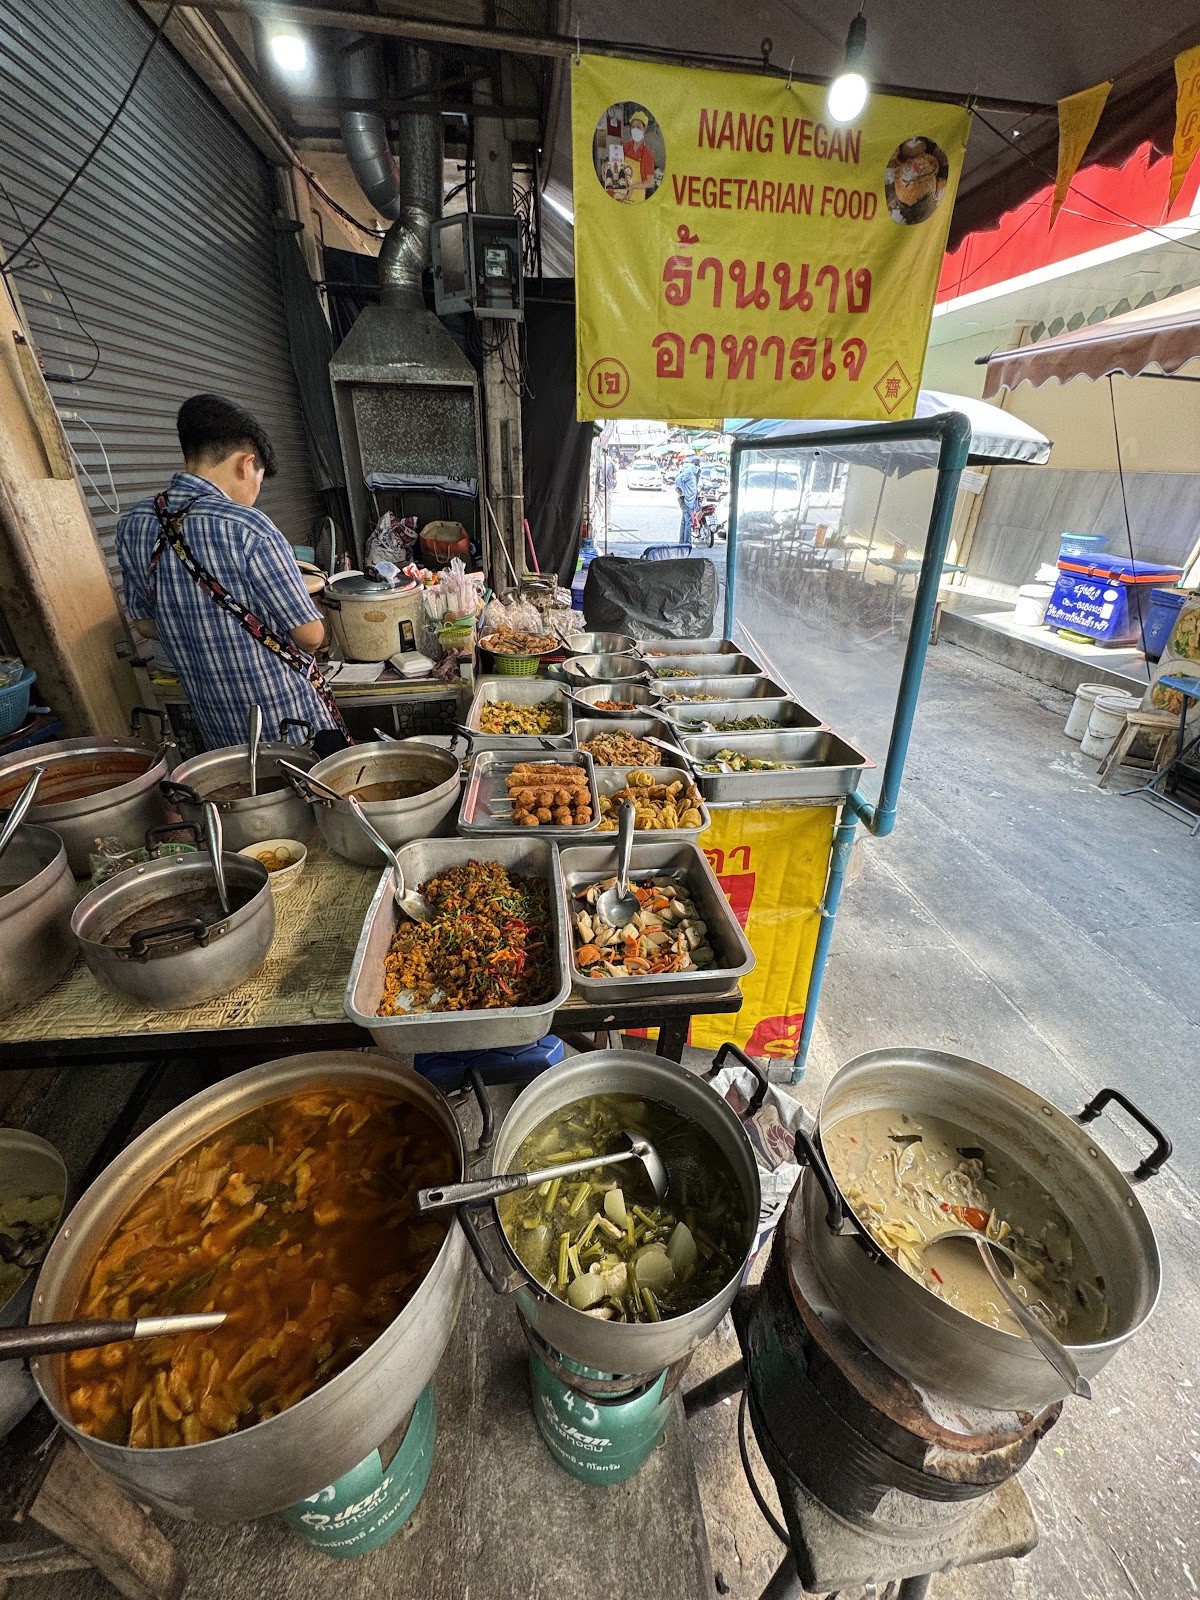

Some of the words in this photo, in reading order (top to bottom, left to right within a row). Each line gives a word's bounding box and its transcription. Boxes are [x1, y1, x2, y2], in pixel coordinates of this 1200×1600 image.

[697, 108, 774, 153] NANG
[783, 117, 862, 165] VEGAN
[671, 174, 813, 216] VEGETARIAN
[820, 186, 878, 221] FOOD
[662, 223, 872, 314] ร้านนาง
[651, 331, 868, 382] อาหารเจ
